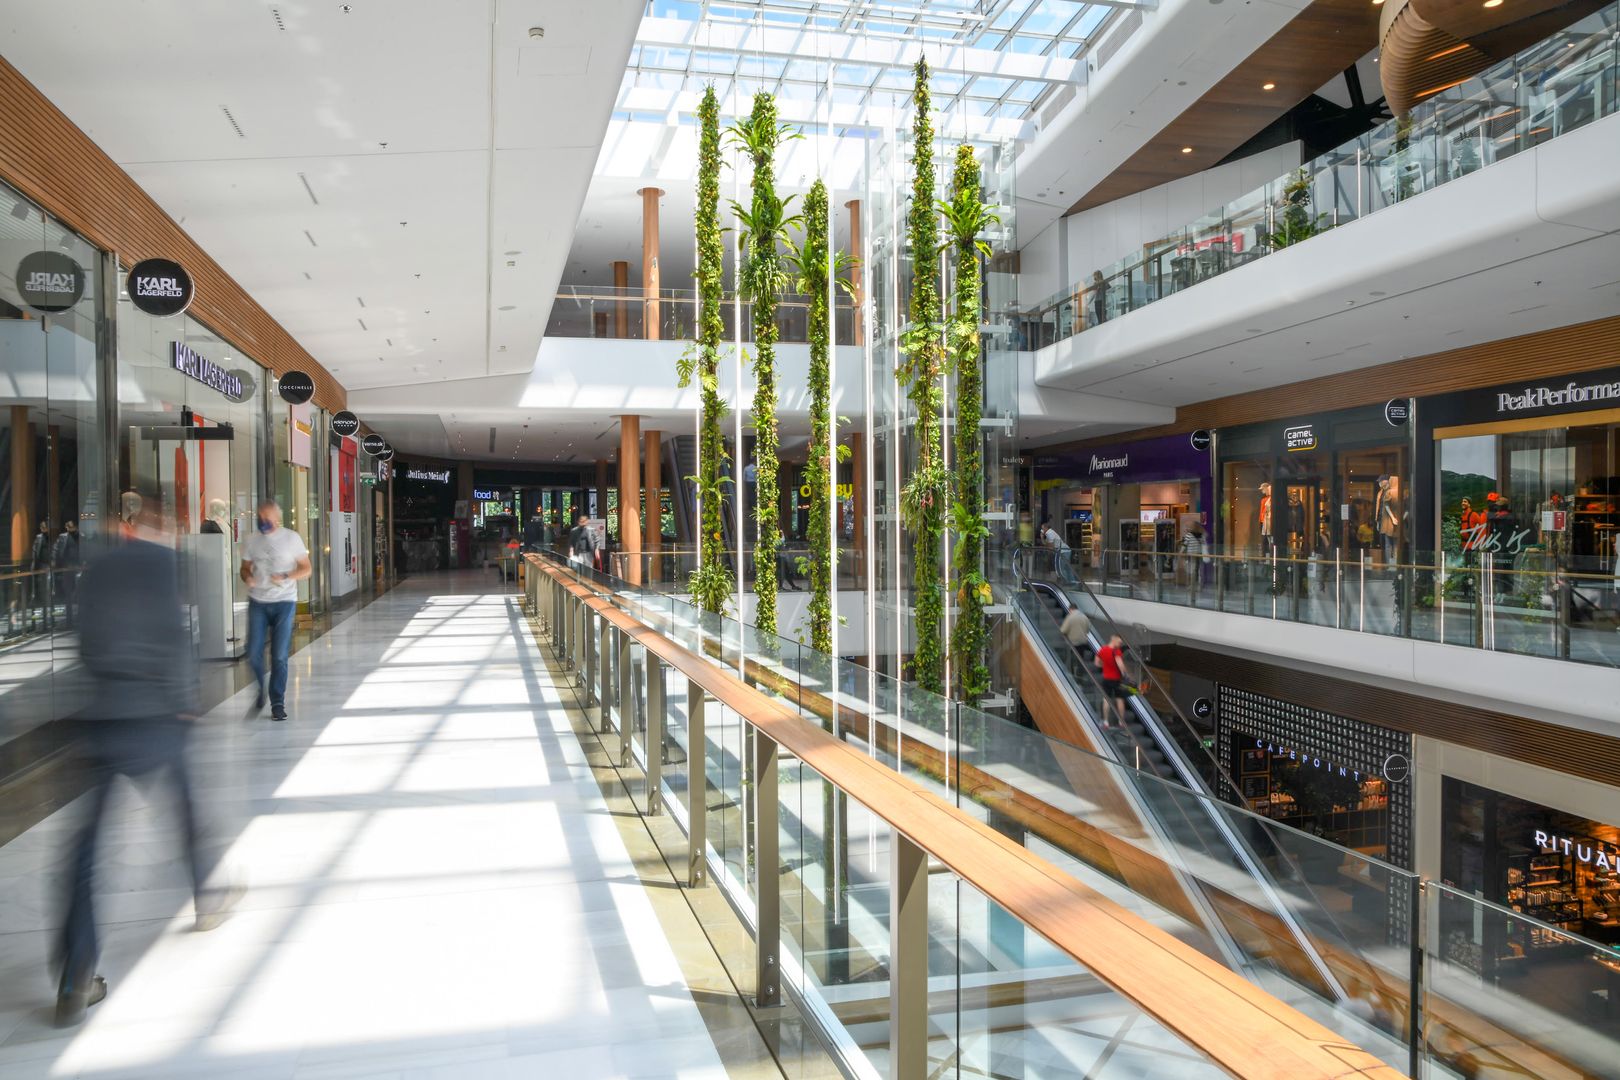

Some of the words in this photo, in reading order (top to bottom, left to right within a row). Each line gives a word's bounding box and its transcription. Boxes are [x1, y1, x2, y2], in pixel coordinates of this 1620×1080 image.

[137, 277, 182, 290] KARL
[137, 289, 182, 297] LAGERFELD
[174, 341, 201, 380] KARL
[200, 356, 242, 399] LAGERFELD
[1287, 430, 1313, 439] camel
[1002, 456, 1025, 465] toalety
[1089, 453, 1128, 475] Marionnaud
[407, 470, 428, 479] Julius
[428, 472, 445, 481] Meinl
[474, 489, 492, 499] food
[1460, 523, 1501, 555] This
[1506, 525, 1531, 554] is
